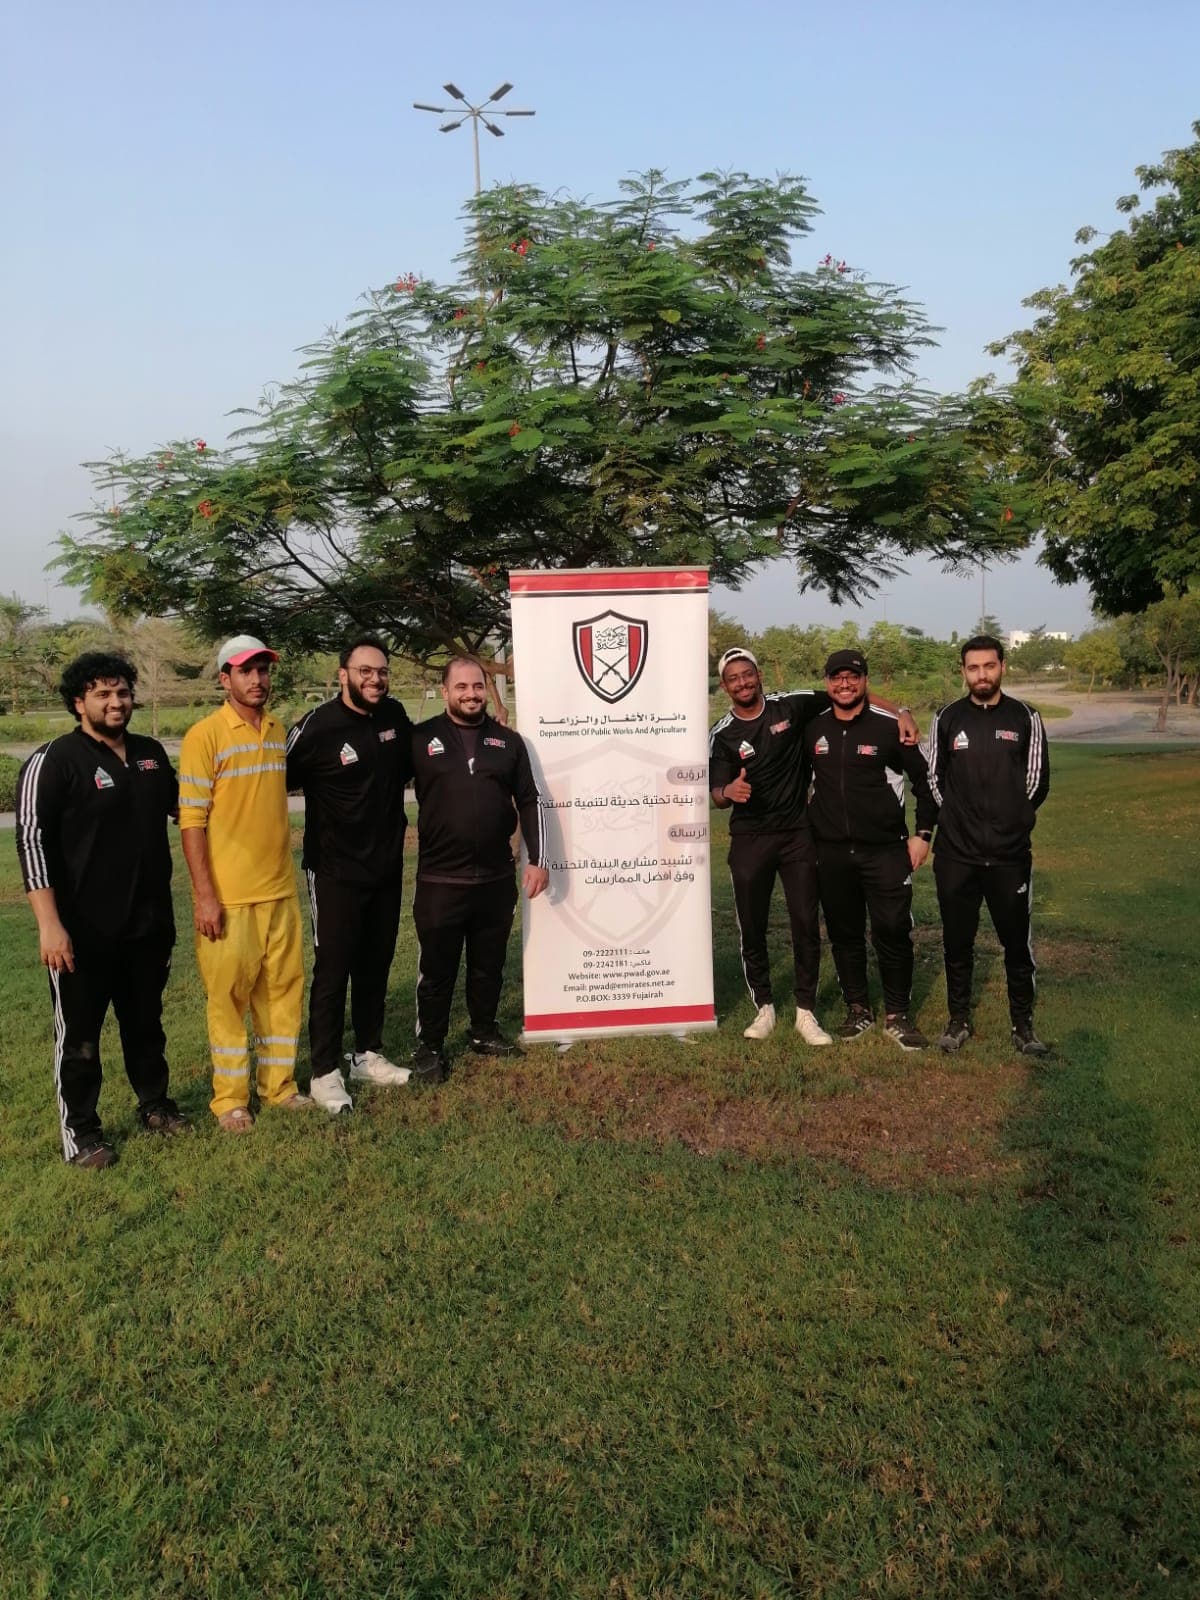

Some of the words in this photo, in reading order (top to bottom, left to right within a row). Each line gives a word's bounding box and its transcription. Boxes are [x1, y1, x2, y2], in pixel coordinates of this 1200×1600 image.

[539, 729, 580, 739] Department
[580, 728, 590, 736] Of
[590, 727, 612, 736] Public
[612, 727, 634, 735] Works
[634, 726, 649, 734] And
[649, 725, 687, 736] Agriculture
[677, 769, 706, 780] الرؤية
[574, 796, 608, 810] لتنمية
[610, 795, 641, 807] حديثة
[642, 795, 671, 809] تحتية
[672, 794, 694, 806] بنية
[670, 827, 707, 839] الرسالة
[551, 859, 589, 871] التحتية
[590, 857, 619, 871] البنية
[620, 856, 658, 870] مشاريع
[660, 855, 693, 867] تشييد
[584, 872, 641, 885] الممارسات
[642, 871, 672, 883] أفضل
[673, 872, 695, 883] وفق
[582, 948, 628, 958] 09-2222111
[582, 960, 628, 969] 09-2242181
[568, 972, 601, 980] Website:
[602, 968, 671, 979] www.pwad.gov.ae
[563, 984, 588, 992] Email:
[588, 979, 676, 992] pwad@emirates.net.ae
[576, 994, 611, 1003] P.O.BOX:
[612, 993, 632, 1001] 3339
[632, 991, 664, 1000] Fujairah
